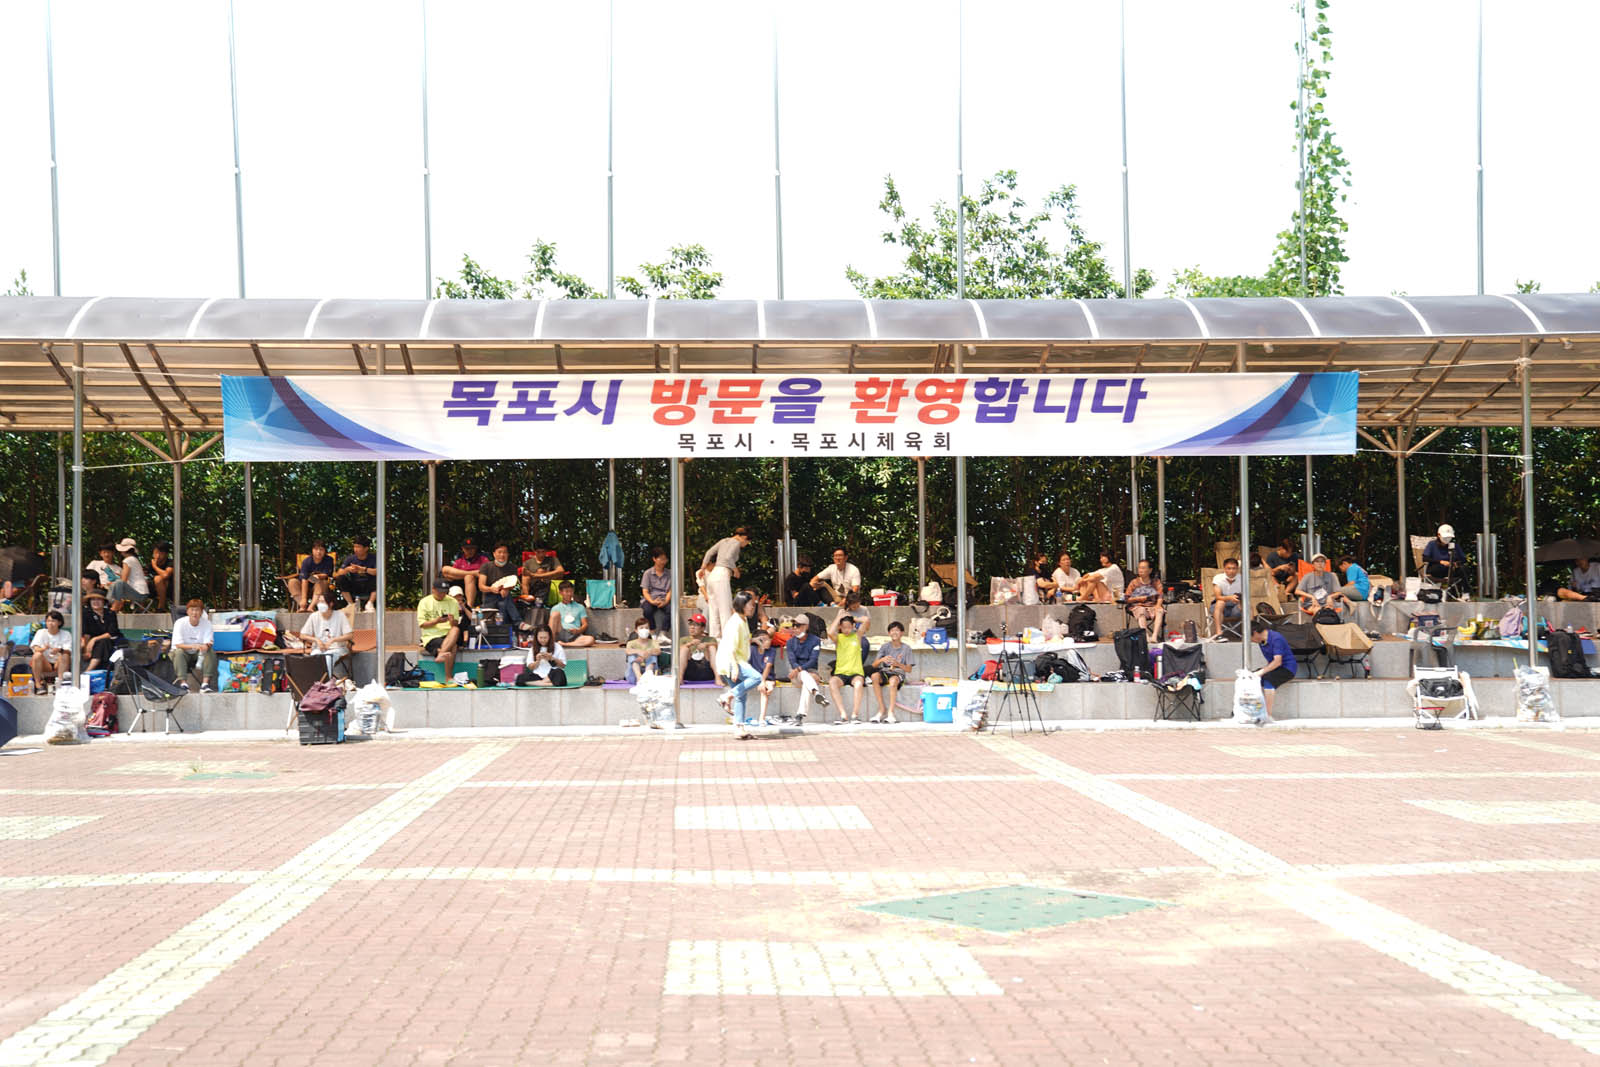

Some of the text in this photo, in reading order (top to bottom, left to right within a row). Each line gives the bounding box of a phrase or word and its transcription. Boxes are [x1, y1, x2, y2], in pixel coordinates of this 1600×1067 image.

[442, 376, 1148, 426] 목포시 방문을 환영합니다
